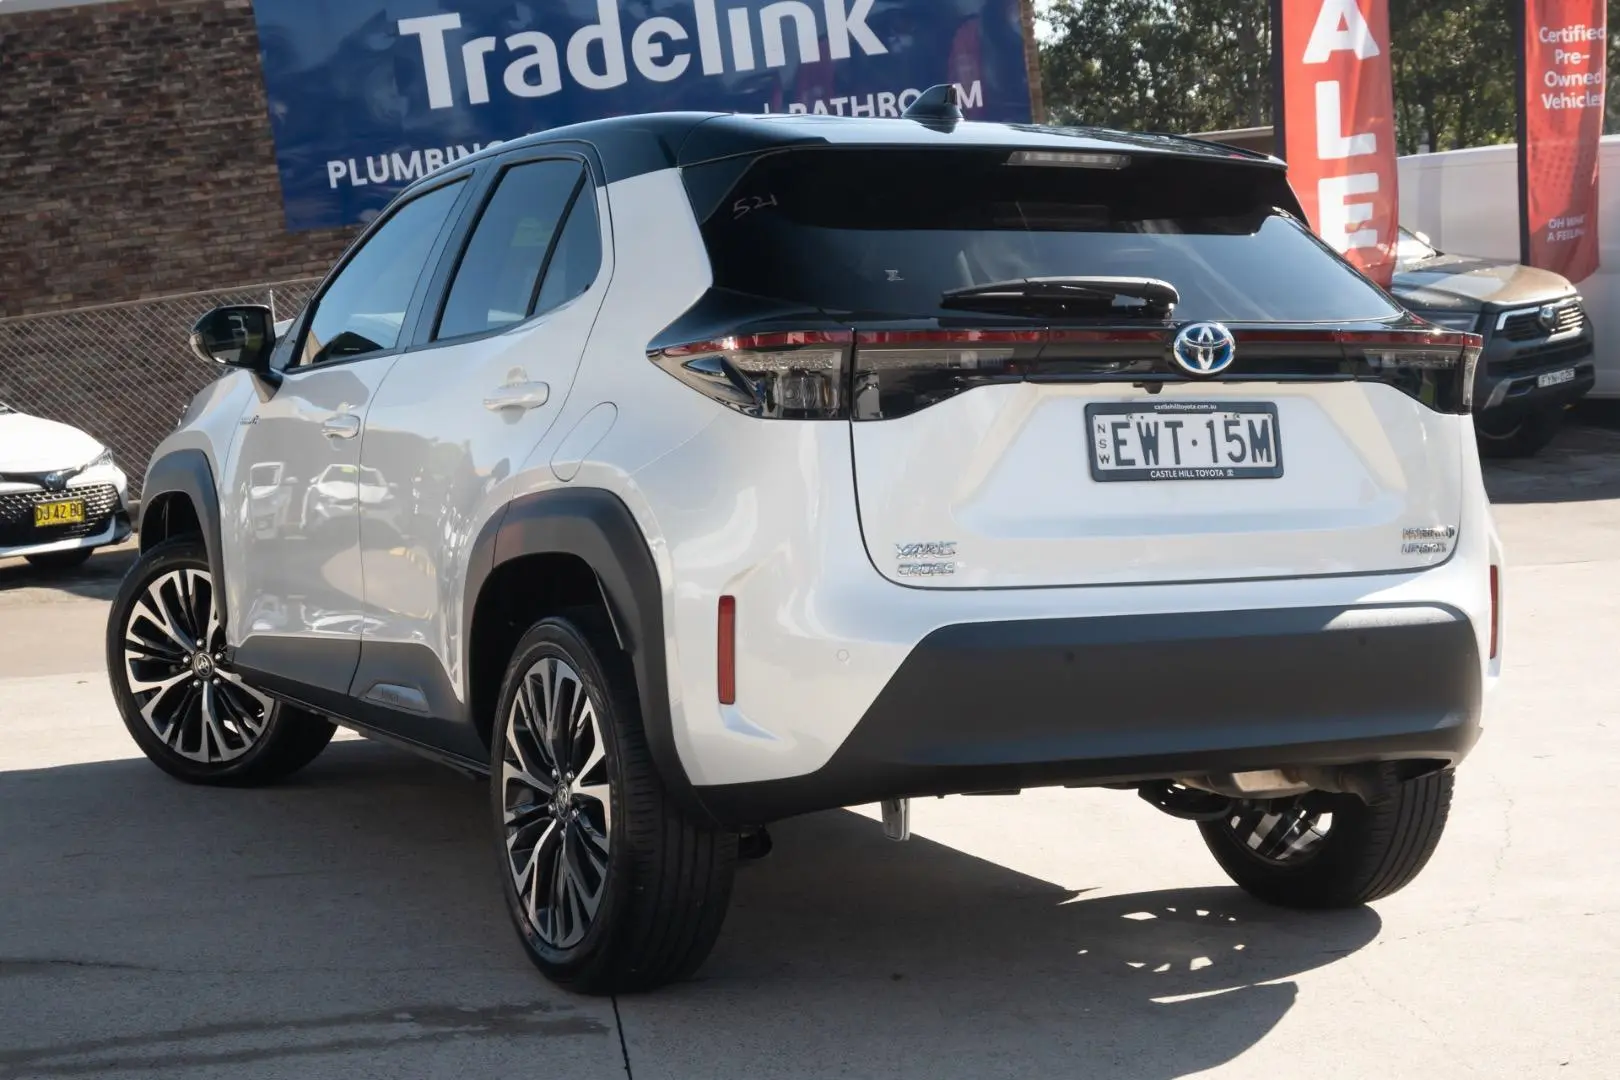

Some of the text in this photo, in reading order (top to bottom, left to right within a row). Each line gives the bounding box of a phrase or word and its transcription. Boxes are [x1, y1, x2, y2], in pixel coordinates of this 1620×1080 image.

[1539, 24, 1605, 43] Certified
[398, 0, 888, 109] Tradelink
[1555, 48, 1590, 65] Pre-
[1544, 69, 1603, 87] Owned
[327, 80, 984, 189] PLUMBIN ATHROM
[733, 194, 778, 220] 521
[1150, 468, 1224, 479] CASTLE HILL TOYOTA
